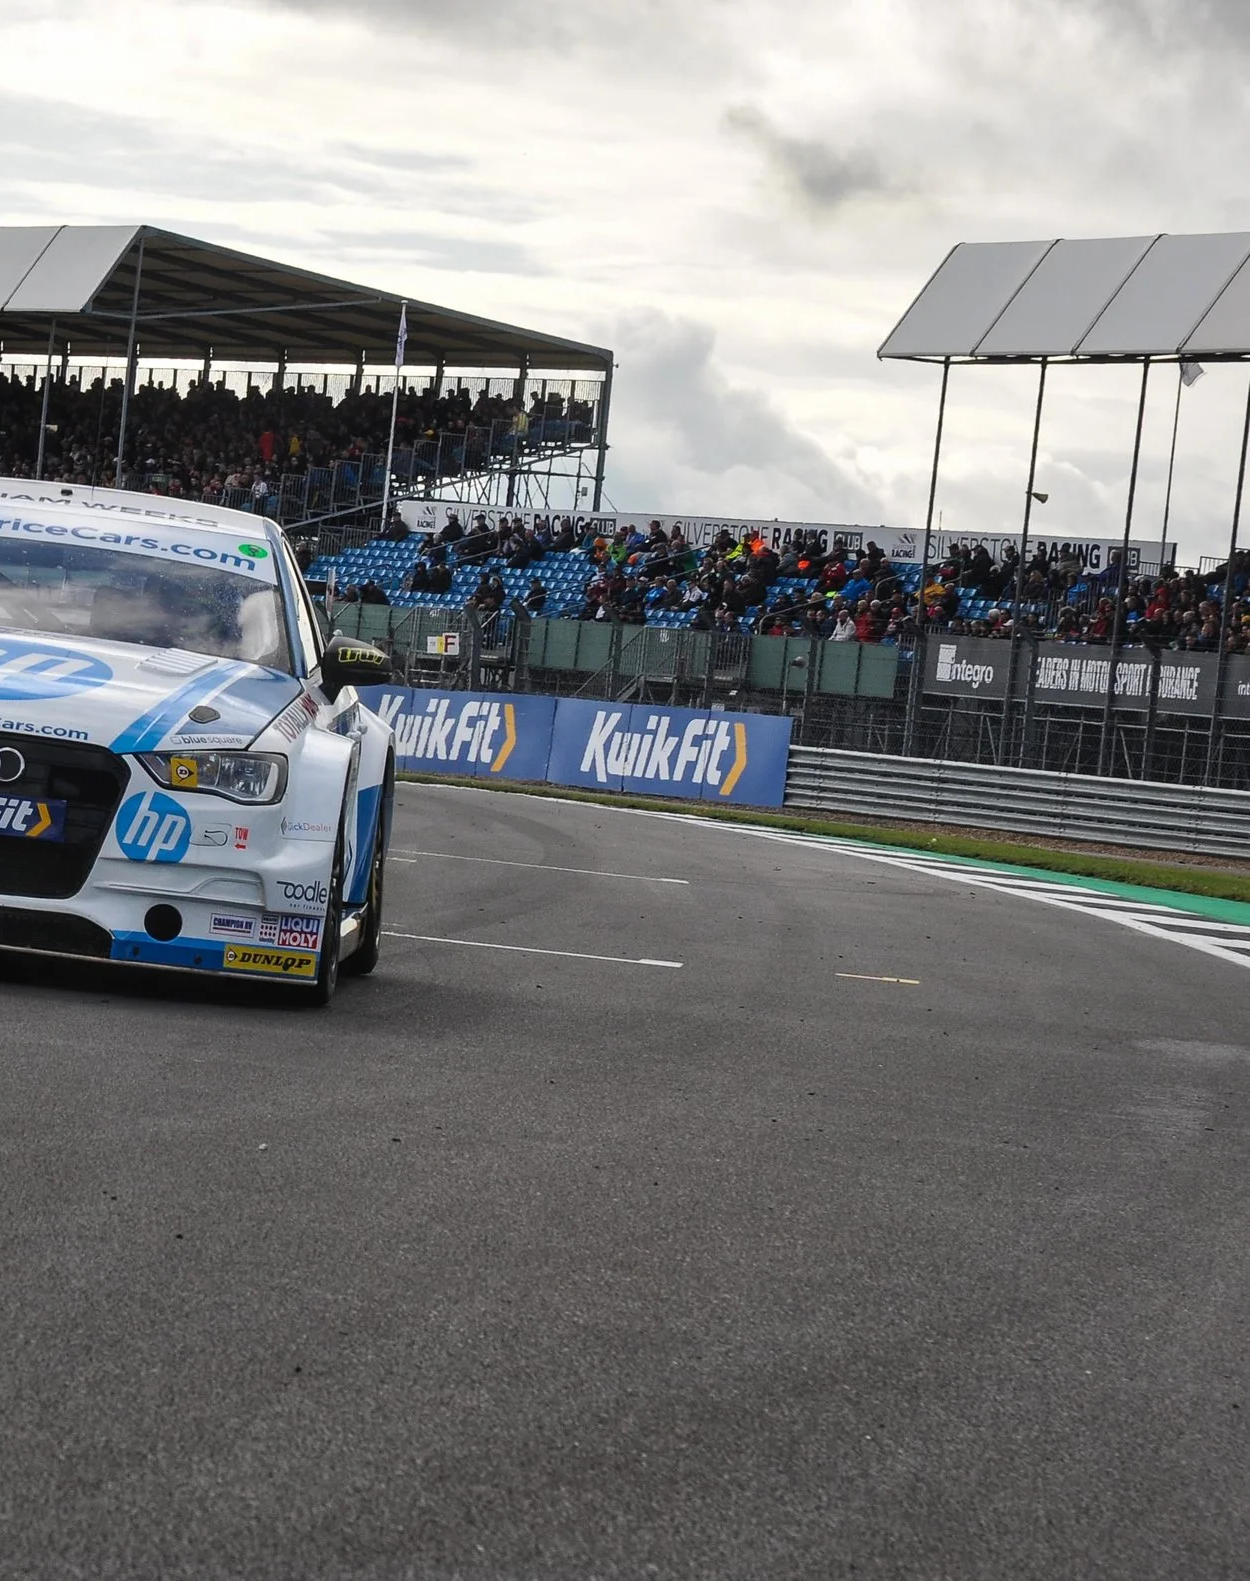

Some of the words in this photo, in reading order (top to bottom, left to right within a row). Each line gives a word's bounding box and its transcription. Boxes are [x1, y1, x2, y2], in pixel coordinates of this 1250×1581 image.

[82, 501, 219, 528] WEEKS
[533, 514, 585, 538] RACNG
[444, 634, 456, 652] F
[1035, 657, 1069, 690] ADERS
[1145, 665, 1201, 700] IURANCE
[182, 736, 244, 746] bluesquare
[580, 710, 731, 786] KwikFit
[122, 792, 187, 862] hp
[235, 827, 249, 841] TOW
[281, 916, 319, 933] LIQUI
[278, 931, 318, 948] MOLY
[238, 951, 312, 970] DUNLOP
